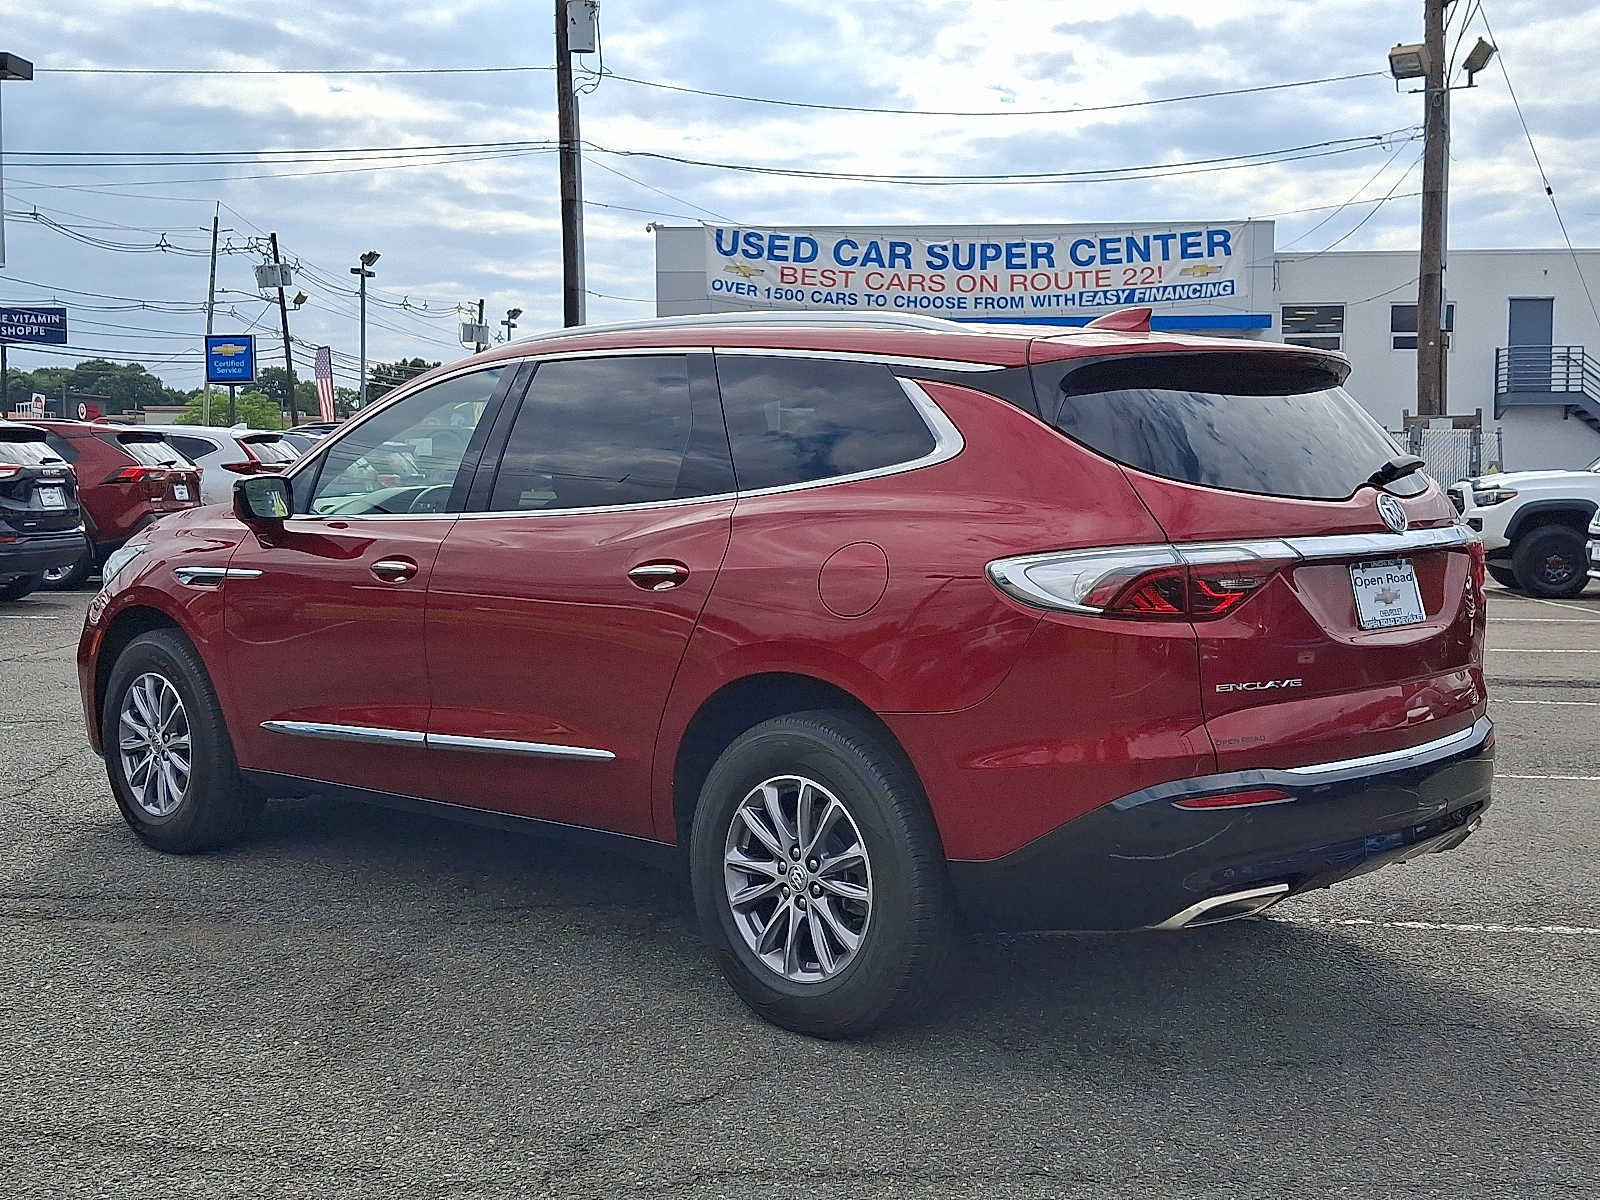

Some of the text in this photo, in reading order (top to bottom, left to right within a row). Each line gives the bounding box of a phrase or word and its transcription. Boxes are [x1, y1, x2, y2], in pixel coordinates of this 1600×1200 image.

[715, 228, 1232, 271] USED CAR SUPER CENTER
[780, 266, 1163, 293] BEST CARS ON ROUTE 22!
[711, 279, 1233, 310] OVER 1500 CARS TO CHOOSE FROM WITH EASY FINANCING
[12, 314, 60, 324] VITAMIN
[1, 326, 46, 336] SHOPPE
[1354, 571, 1413, 589] Open Road
[1215, 679, 1303, 692] ENCLAVE
